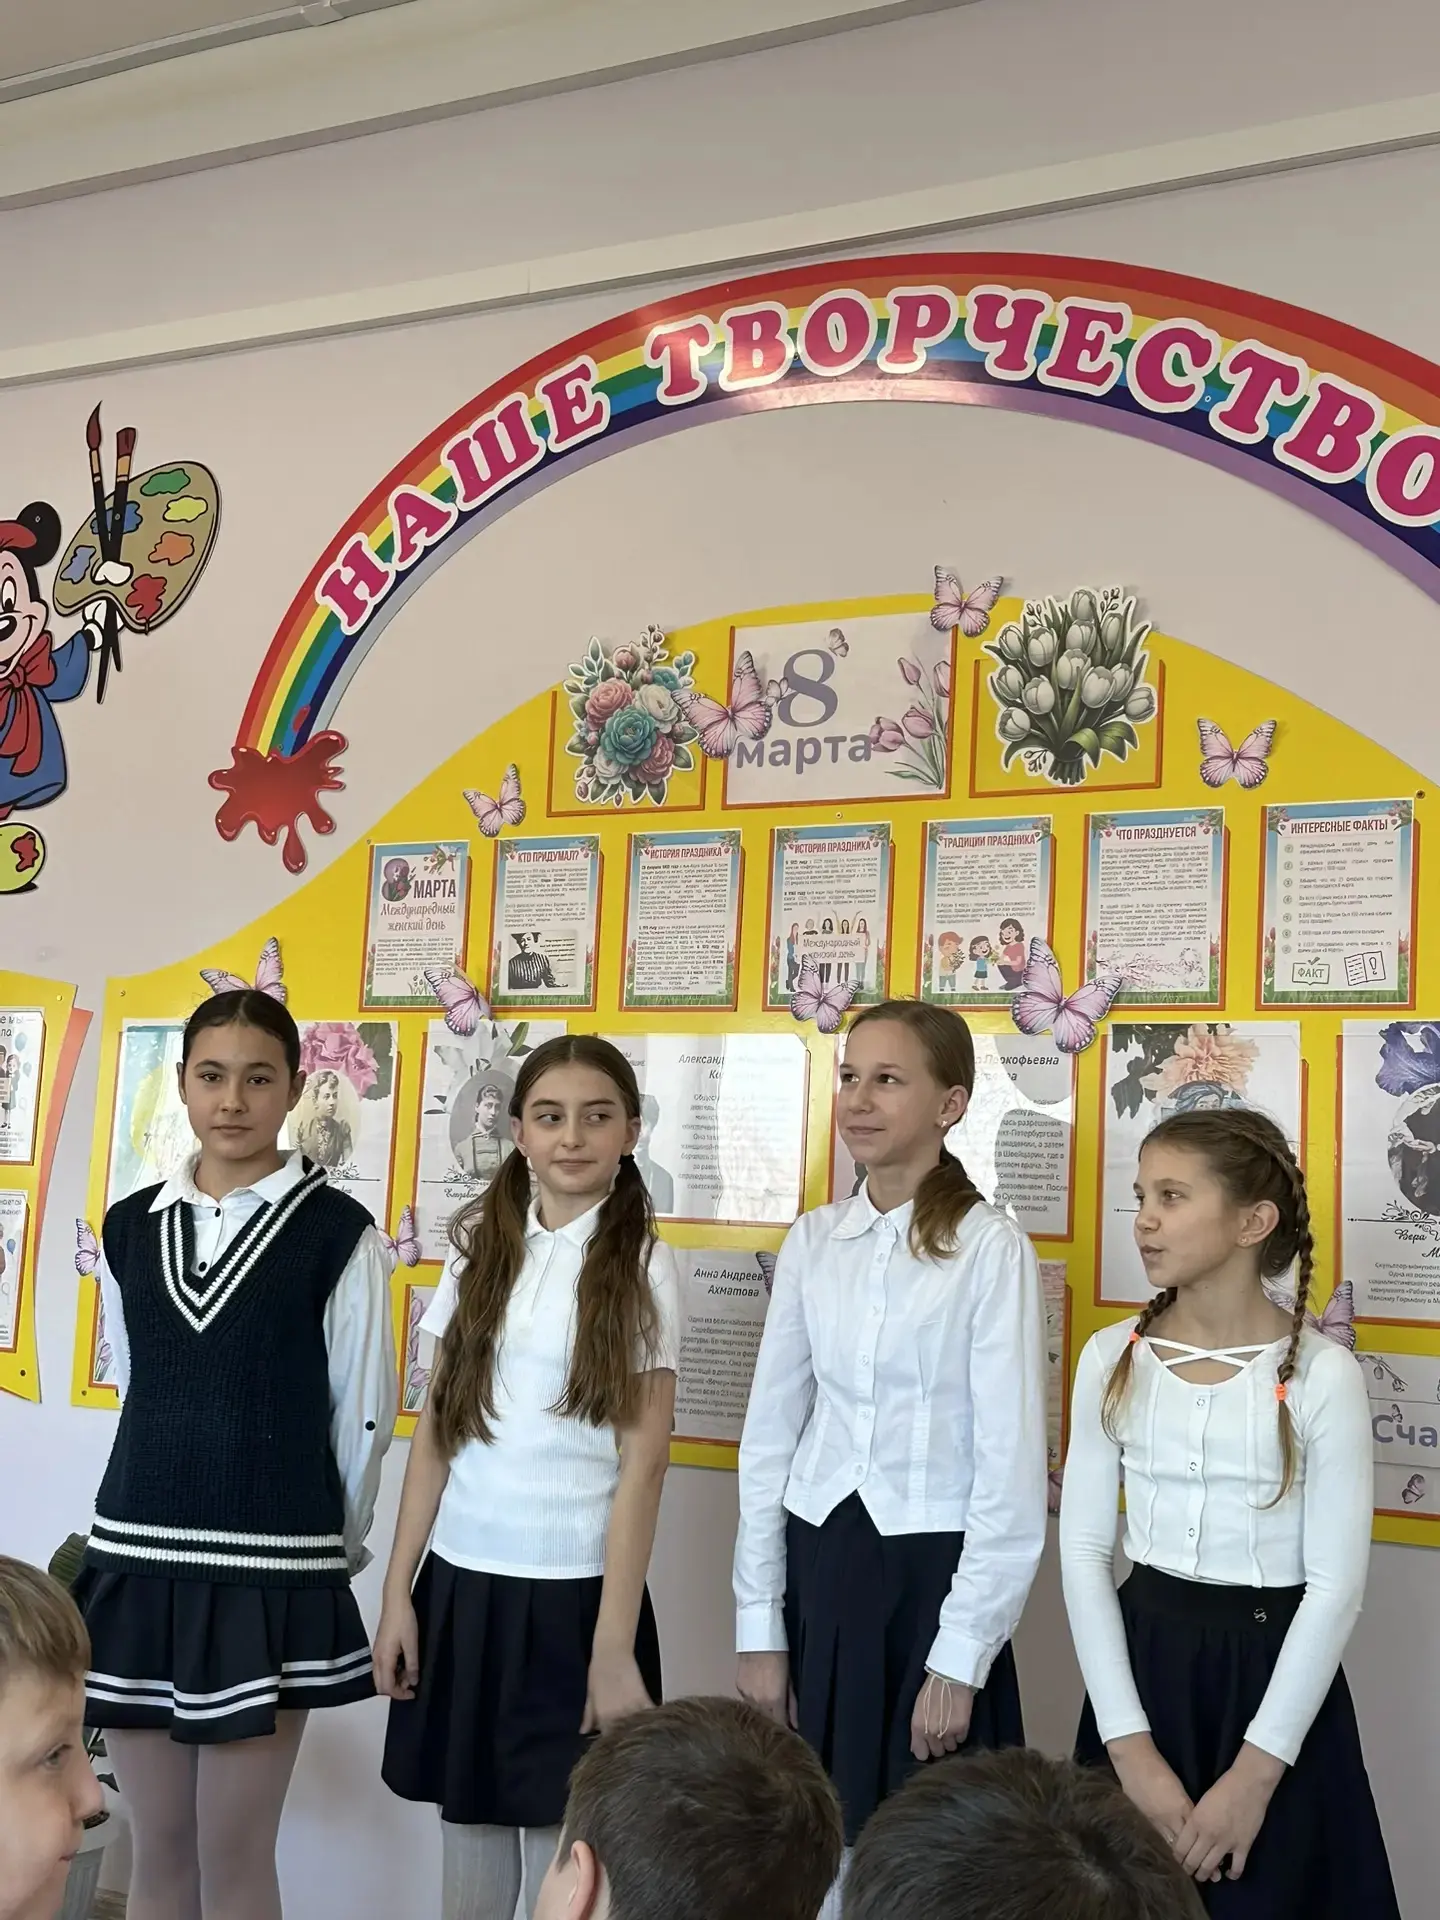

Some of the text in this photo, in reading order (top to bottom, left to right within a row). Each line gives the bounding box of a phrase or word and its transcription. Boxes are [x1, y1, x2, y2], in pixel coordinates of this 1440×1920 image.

[318, 290, 1440, 631] НАШЕ ТВОРЧЕСТВО
[778, 648, 838, 727] 8
[736, 732, 872, 775] марта
[1116, 826, 1196, 840] ЧТО ПРАЗДНУЕТСЯ
[1291, 818, 1388, 835] ИНТЕРЕСНЫЕ ФАКТЫ
[795, 840, 871, 854] ИСТОРИЯ ПРАЗДНИКА
[944, 833, 1035, 848] ТРАДИЦИИ ПРАЗДНИКА
[518, 850, 579, 863] КТО ПРИДУМАЛ?
[650, 847, 722, 859] ИСТОРИЯ ПРАЗДНИКА
[413, 879, 456, 899] МАРТА
[380, 902, 456, 919] Международный
[387, 917, 446, 931] женский день
[1297, 967, 1325, 979] ФАКТ
[1395, 1229, 1427, 1244] Вера
[693, 1268, 719, 1279] Анна
[708, 1284, 760, 1297] Ахматова
[1371, 1414, 1438, 1448] Сча
